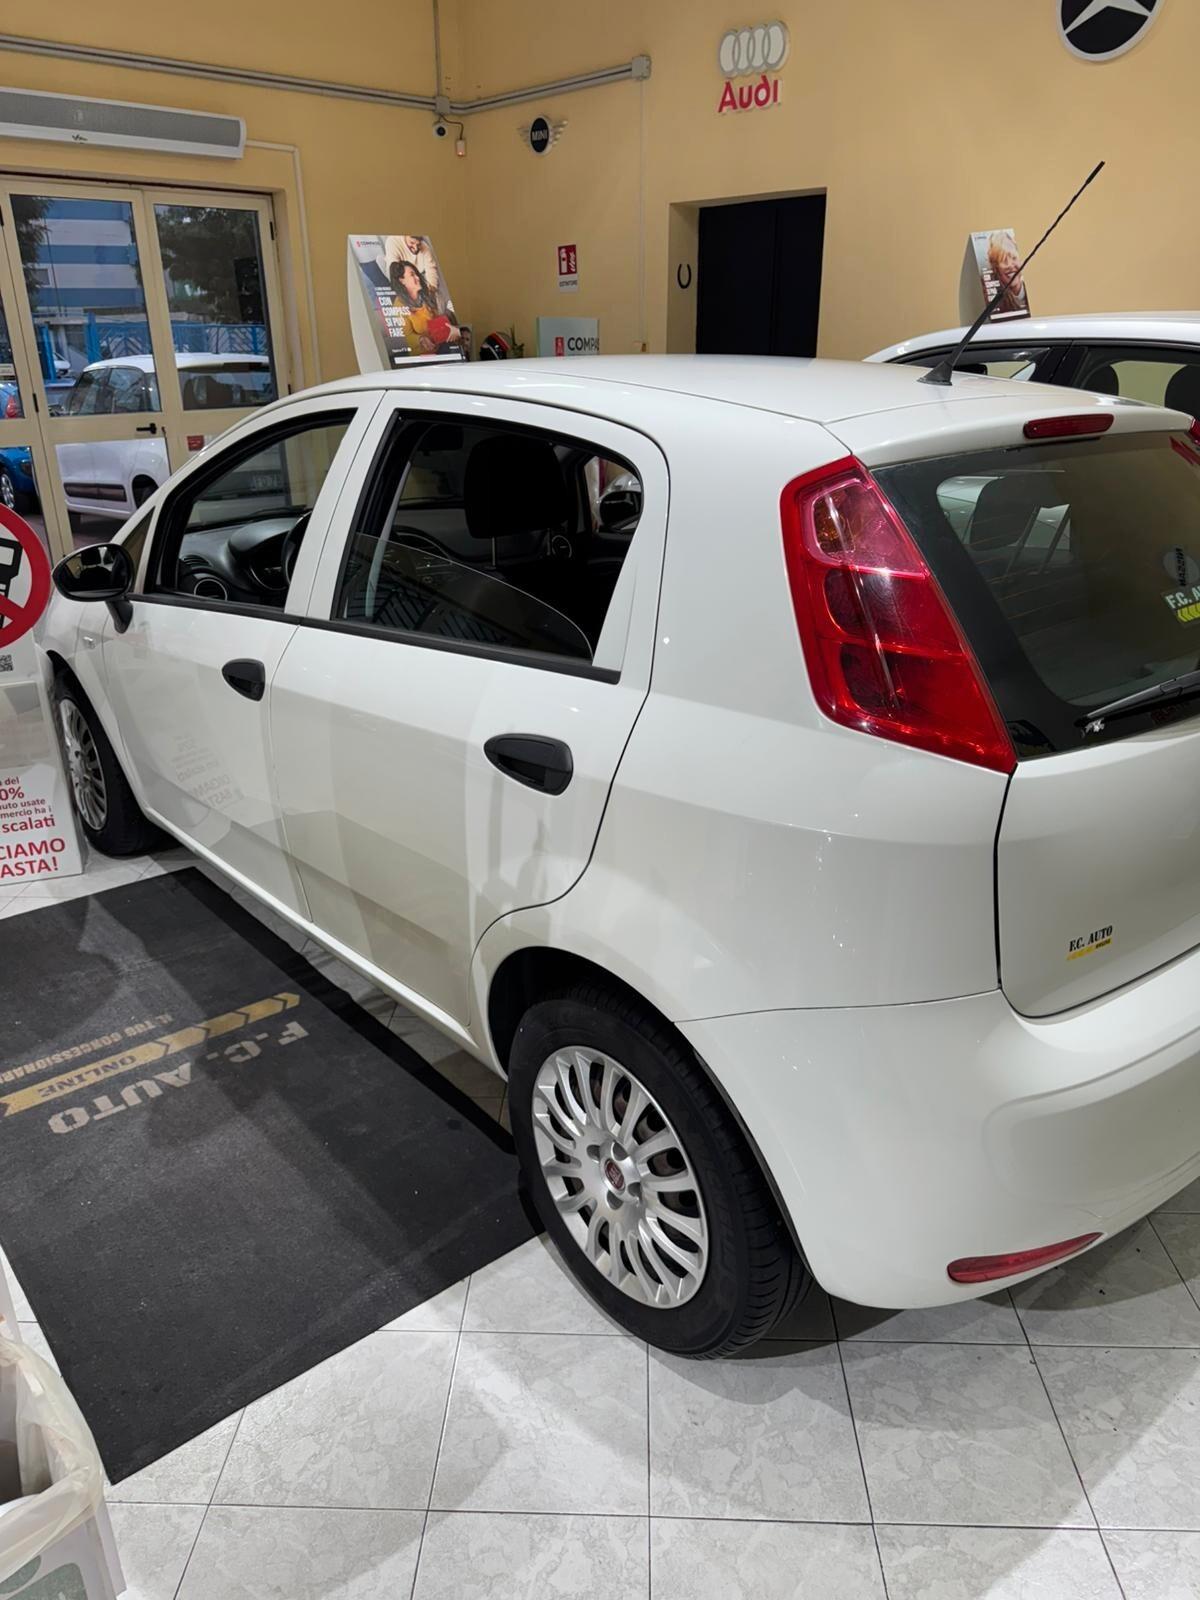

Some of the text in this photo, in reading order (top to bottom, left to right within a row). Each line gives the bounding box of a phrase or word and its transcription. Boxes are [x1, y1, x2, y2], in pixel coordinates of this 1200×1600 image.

[718, 75, 779, 113] Audi
[531, 129, 548, 141] MINI
[378, 296, 393, 306] CON
[382, 306, 411, 316] COMPASS
[385, 317, 394, 327] SI
[389, 327, 405, 337] FARE
[1165, 591, 1193, 609] F.C.
[4, 776, 19, 785] del
[20, 798, 46, 809] usate
[34, 806, 46, 815] ha
[2, 814, 56, 833] scalati
[0, 856, 58, 879] ASTA!
[1088, 925, 1113, 945] AUTO
[37, 1055, 137, 1098] ONLINE
[48, 1062, 191, 1134] AUTO
